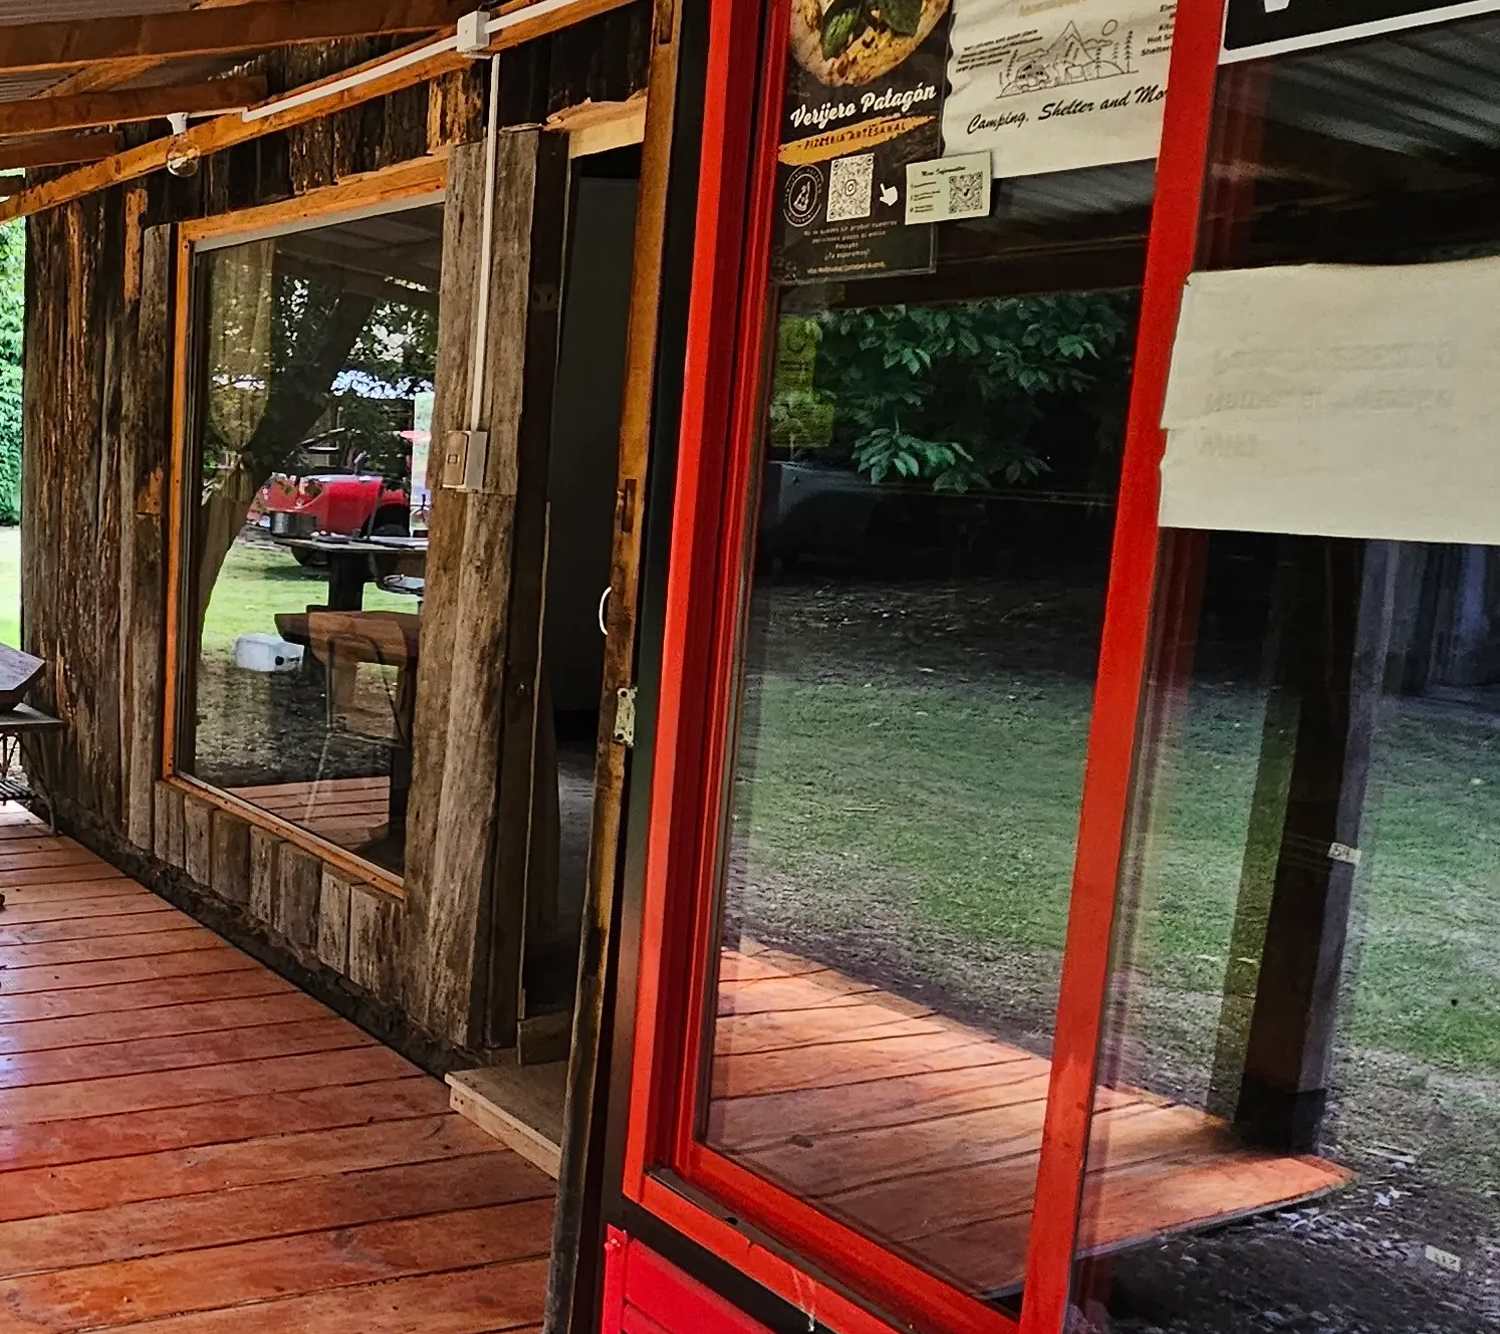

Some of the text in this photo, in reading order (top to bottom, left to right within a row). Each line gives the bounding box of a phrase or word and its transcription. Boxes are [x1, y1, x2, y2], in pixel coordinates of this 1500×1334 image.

[860, 82, 937, 114] Patagón
[1037, 98, 1095, 121] Shelter
[1100, 92, 1128, 114] and
[1134, 84, 1169, 105] Mo
